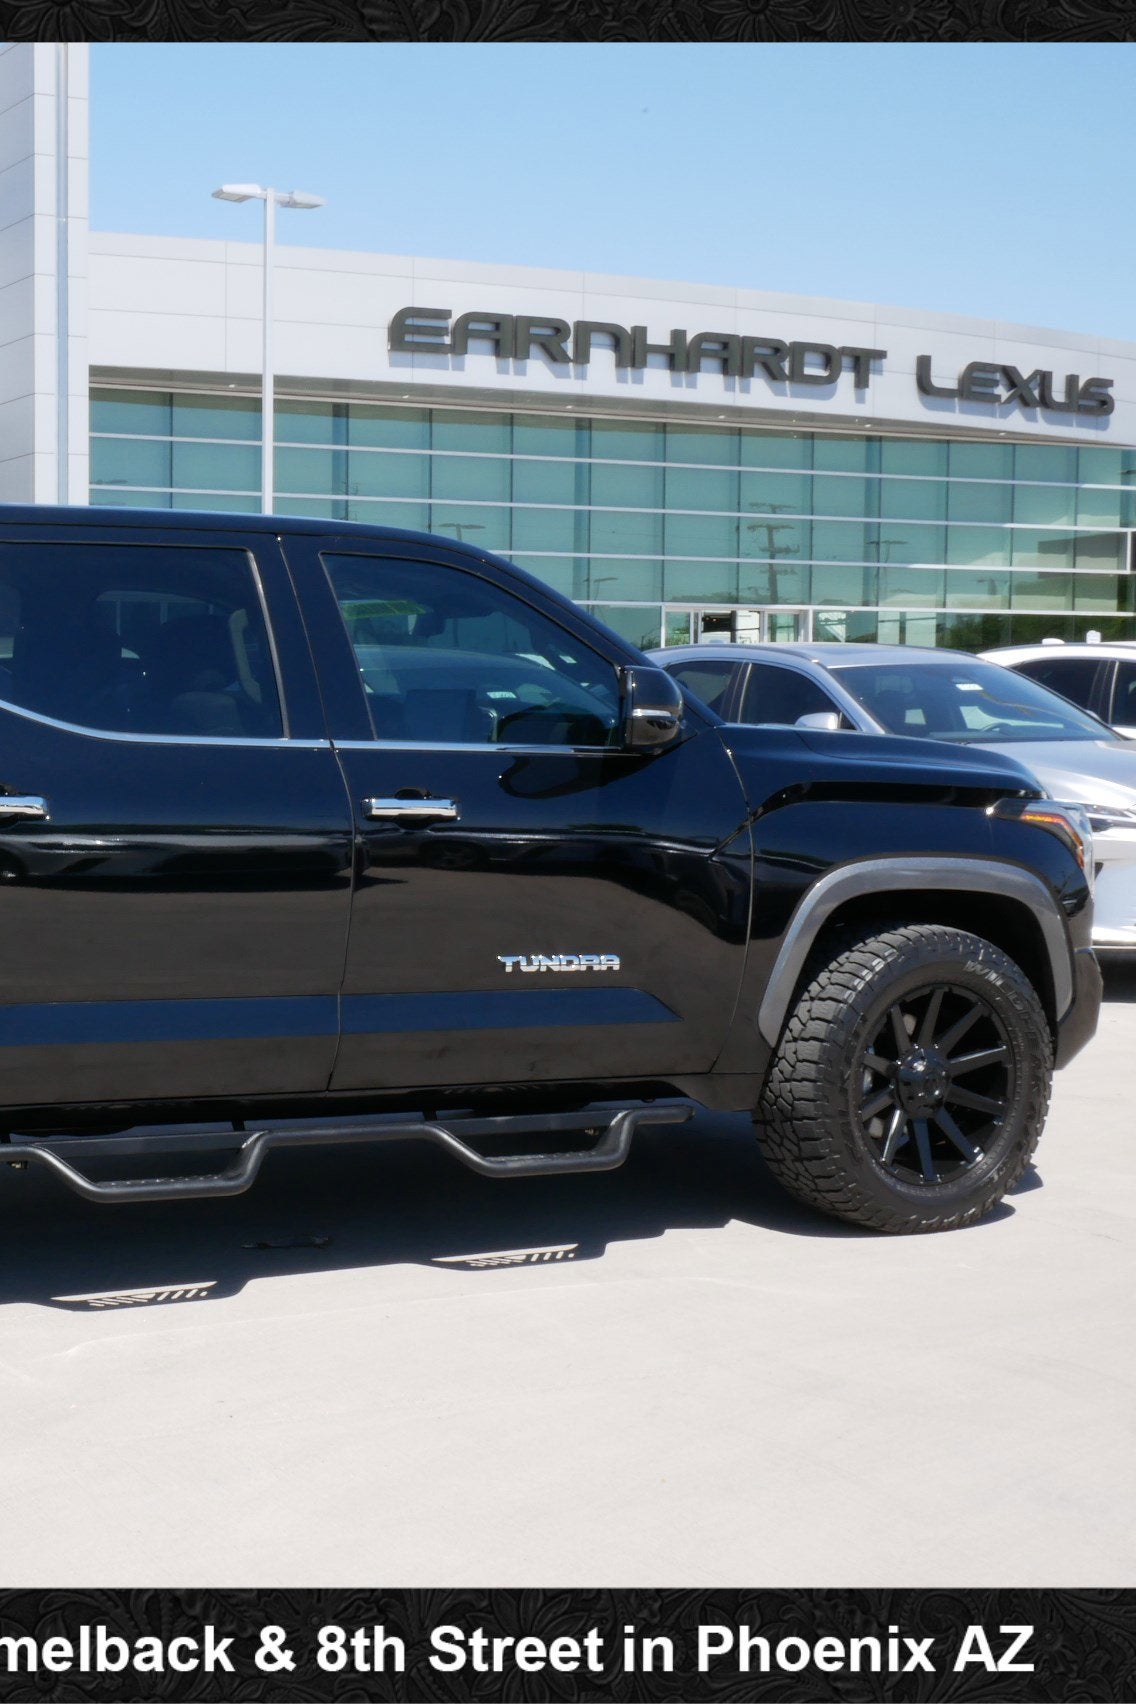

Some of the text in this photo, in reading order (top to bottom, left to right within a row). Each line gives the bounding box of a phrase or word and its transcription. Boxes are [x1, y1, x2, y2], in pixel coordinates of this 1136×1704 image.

[387, 306, 1115, 417] EARNHARDT LEXUS
[496, 954, 621, 973] TUNDRA
